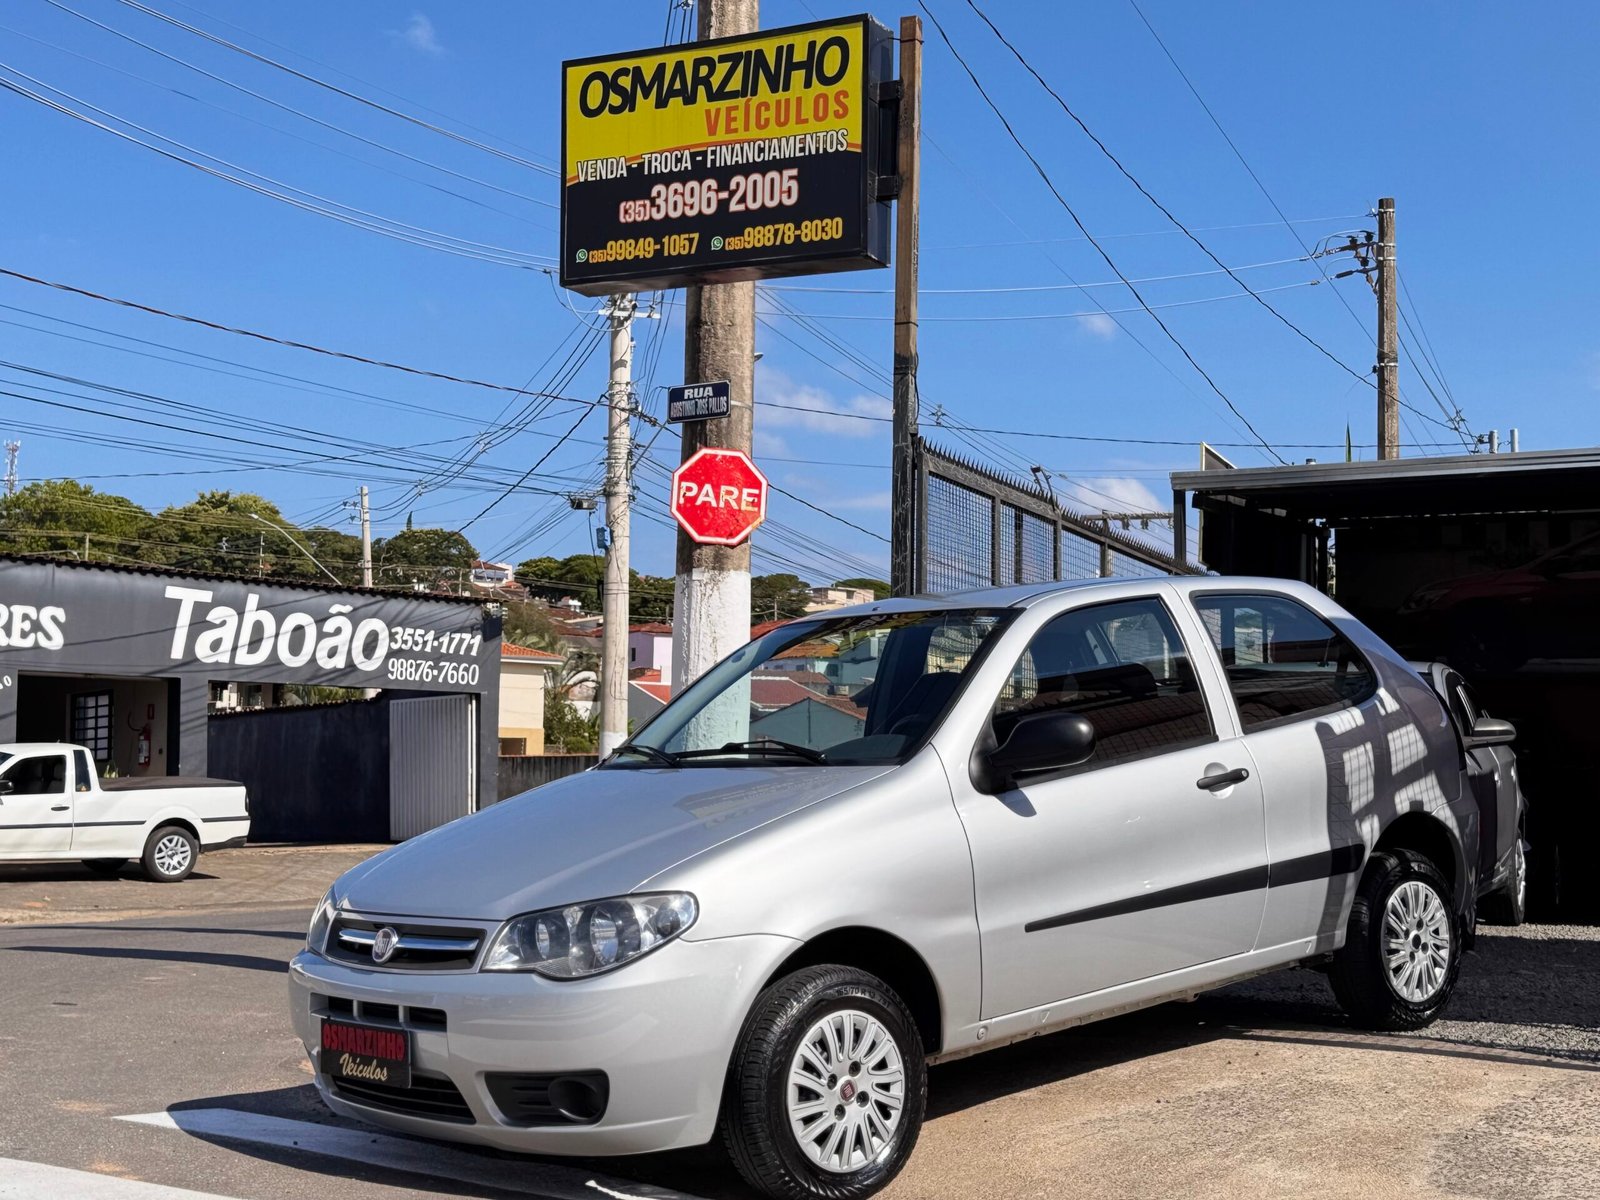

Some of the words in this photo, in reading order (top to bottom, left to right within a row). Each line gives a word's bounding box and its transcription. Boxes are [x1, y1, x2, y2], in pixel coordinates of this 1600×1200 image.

[579, 36, 850, 118] OSMARZINHO
[705, 89, 850, 137] VEÍCULOS
[576, 156, 627, 183] VENDA
[642, 150, 691, 177] TROCA
[706, 128, 848, 168] FINANCIAMENTOS
[618, 168, 799, 223] (35)3696-2005
[684, 386, 714, 399] RUA
[679, 481, 759, 512] PARE
[165, 585, 390, 672] Taboão
[323, 1023, 405, 1062] OSMARZINHO
